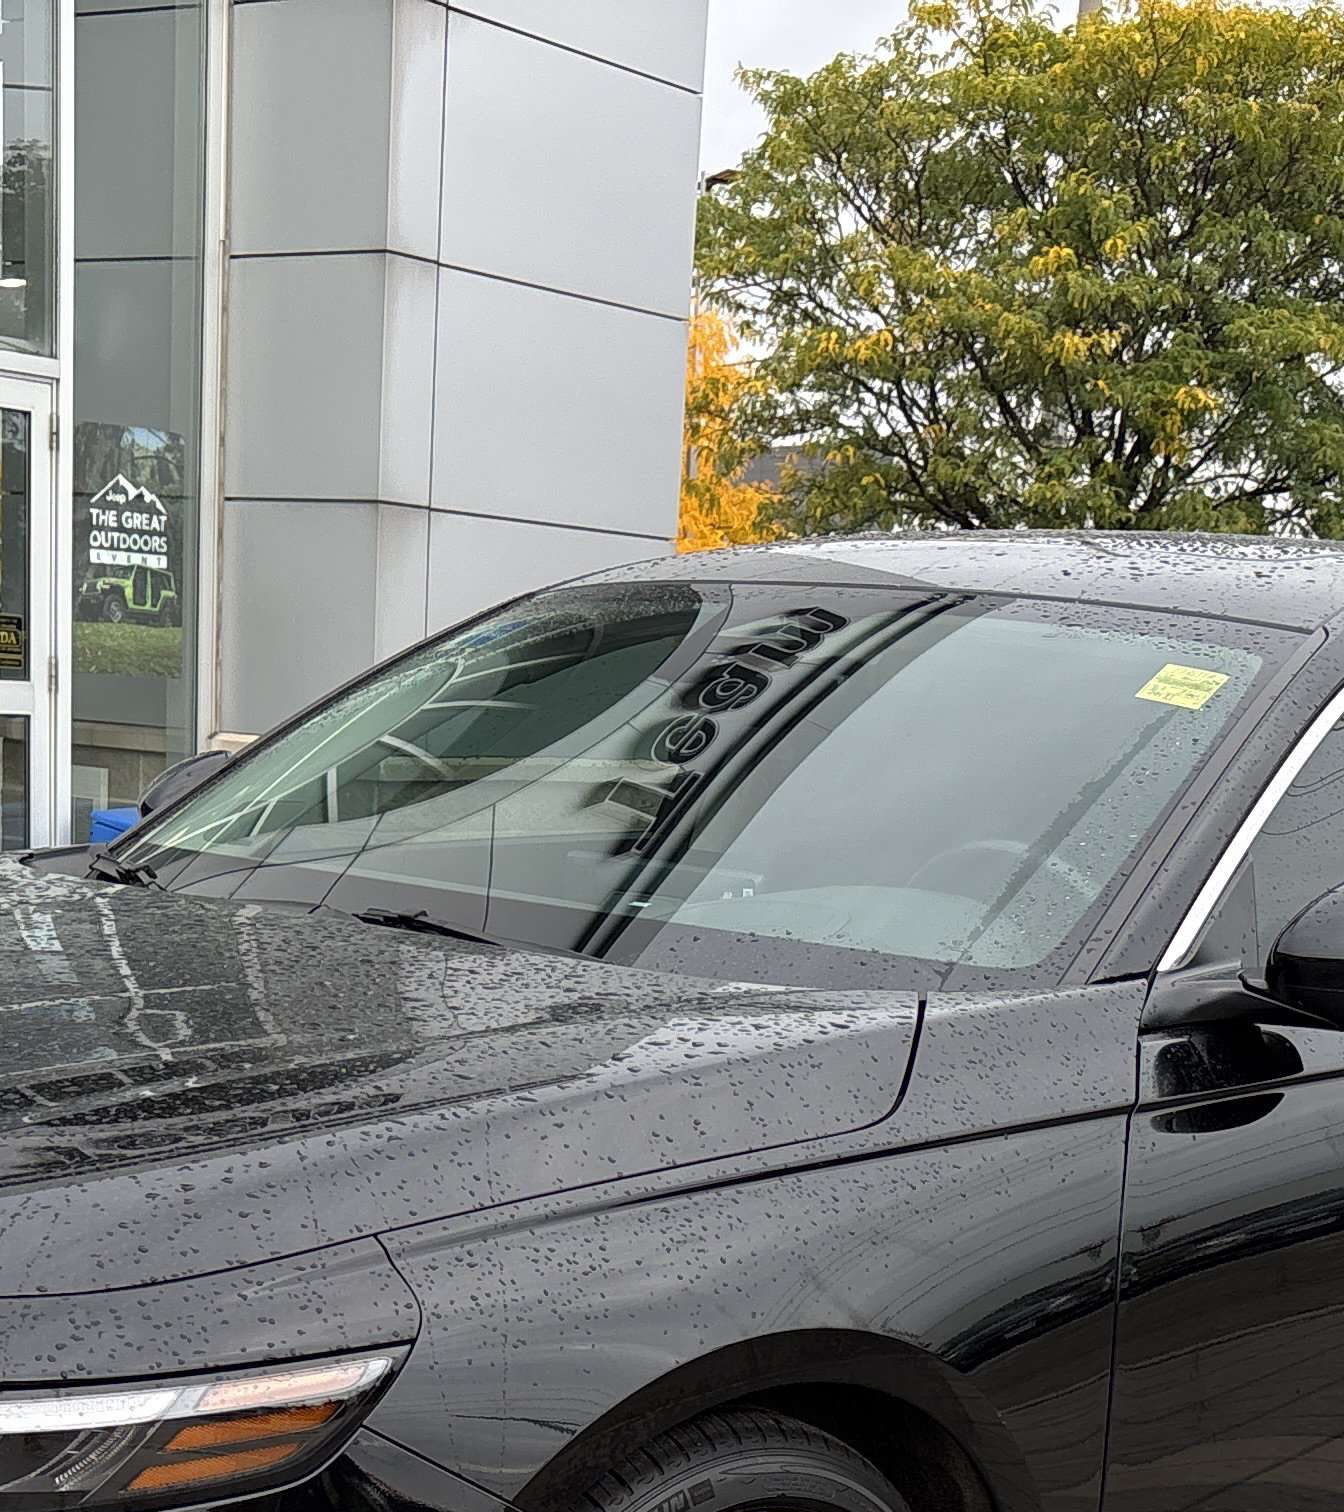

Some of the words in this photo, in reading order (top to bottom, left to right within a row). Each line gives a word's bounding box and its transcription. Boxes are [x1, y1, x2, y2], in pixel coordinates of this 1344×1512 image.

[89, 508, 117, 527] THE
[121, 512, 168, 532] GREAT
[89, 531, 167, 552] OUTDOORS
[96, 552, 162, 566] EVENT
